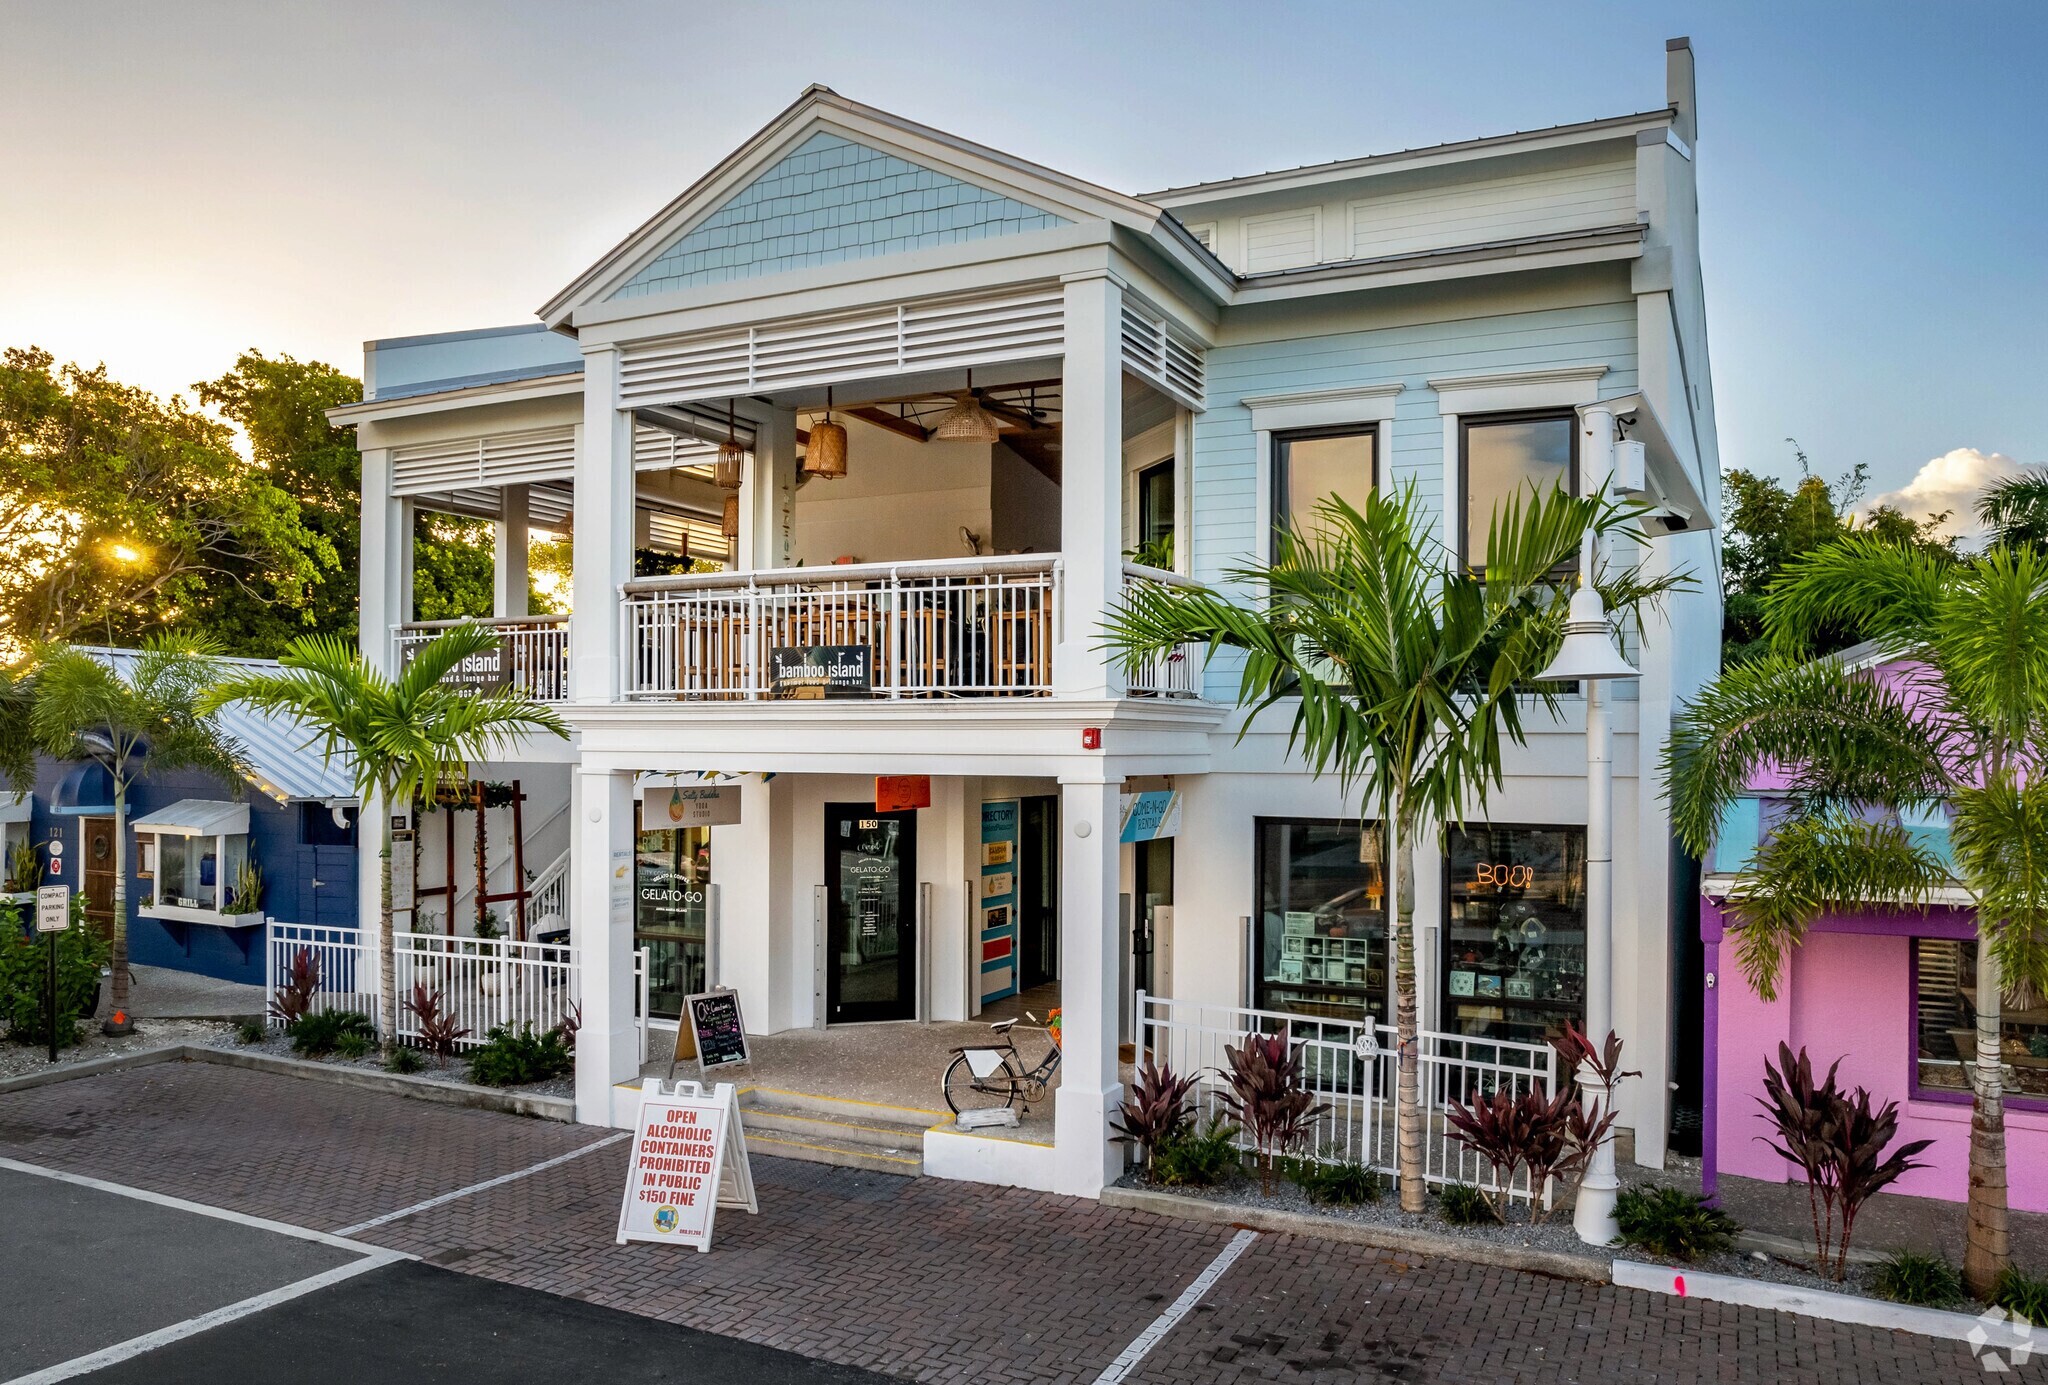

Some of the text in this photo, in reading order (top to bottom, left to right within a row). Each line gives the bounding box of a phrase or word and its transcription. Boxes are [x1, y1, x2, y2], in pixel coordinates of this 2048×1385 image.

[779, 652, 863, 678] bamboo island
[463, 674, 485, 684] lounge
[488, 674, 500, 682] bar
[682, 789, 720, 802] Salty Buddha
[693, 810, 710, 818] STUDIO
[49, 828, 63, 838] 121
[653, 873, 670, 882] GELATO
[673, 873, 690, 884] COFFEE
[1477, 862, 1533, 889] BOO!
[178, 897, 199, 908] GRILL
[667, 1109, 697, 1124] OPEN
[647, 1124, 713, 1142] ALCOHOLIC
[640, 1140, 715, 1159] CONTAINERS
[639, 1156, 711, 1174] PROHIBITED
[643, 1173, 702, 1190] IN PUBLIC
[639, 1190, 696, 1206] $150 FINE
